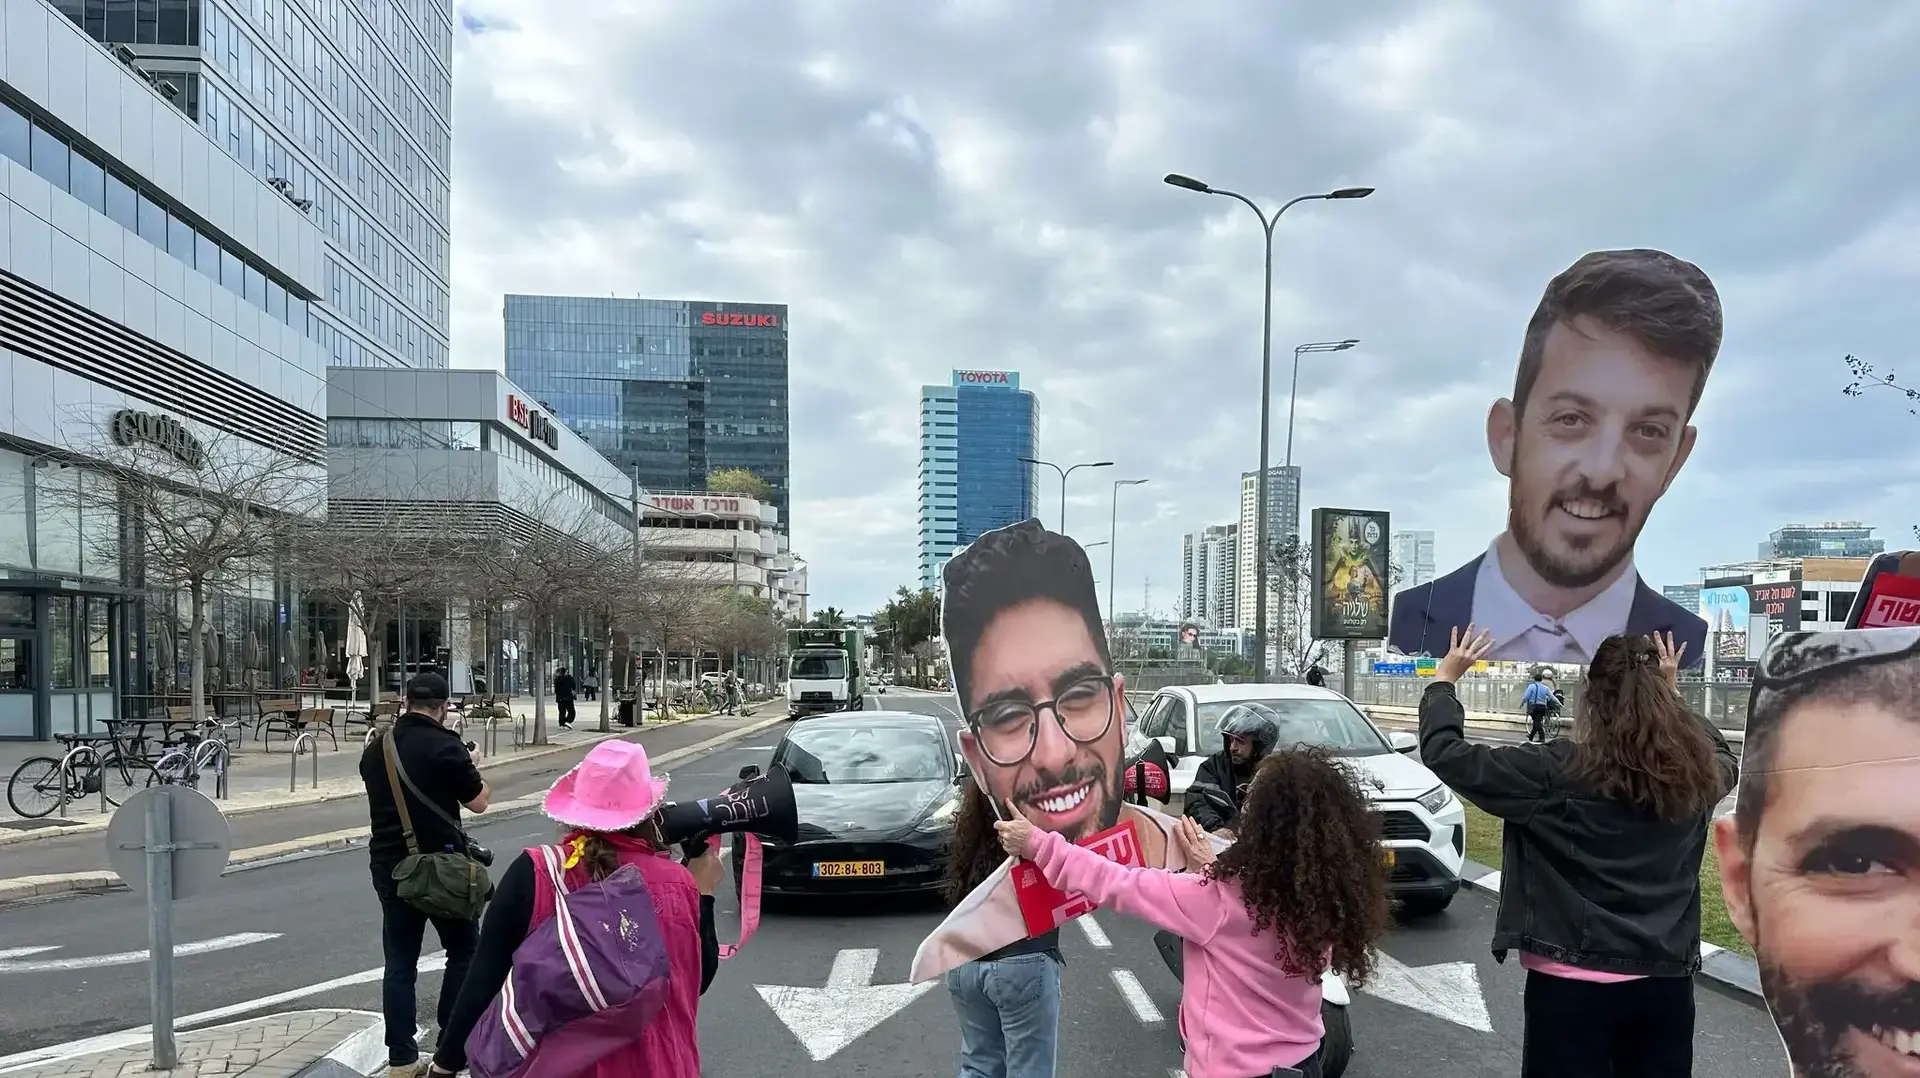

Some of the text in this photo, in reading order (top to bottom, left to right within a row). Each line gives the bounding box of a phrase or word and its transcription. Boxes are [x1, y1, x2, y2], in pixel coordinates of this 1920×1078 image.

[702, 312, 777, 327] SUZUKI
[958, 372, 1008, 384] TOYOTA
[651, 497, 739, 511] מרכז אשדר
[1342, 597, 1369, 617] שלגיה
[1878, 599, 1920, 624] טוף
